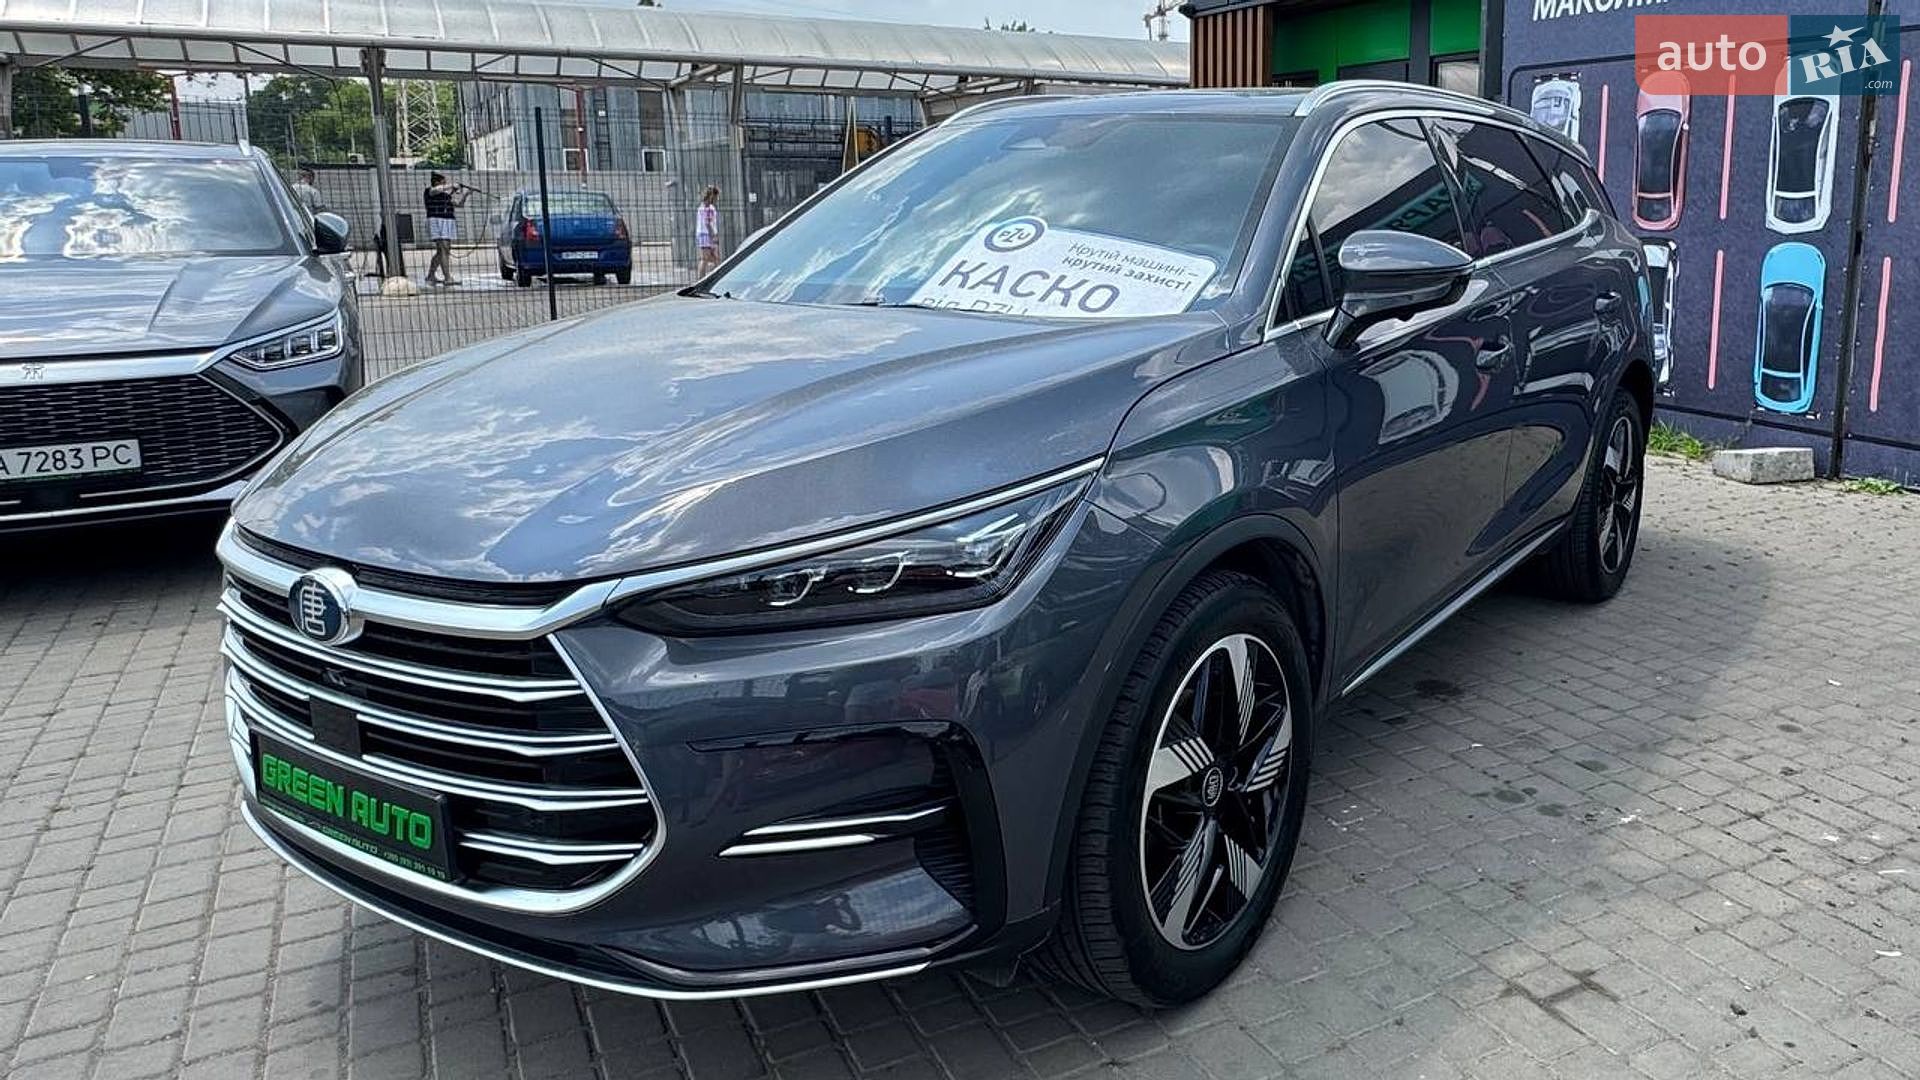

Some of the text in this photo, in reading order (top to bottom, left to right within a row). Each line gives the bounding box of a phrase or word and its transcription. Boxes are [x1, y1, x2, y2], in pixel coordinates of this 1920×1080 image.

[938, 259, 1121, 313] КАСКО
[1124, 269, 1192, 290] захист!
[17, 447, 84, 474] 7283
[92, 444, 132, 468] PC
[262, 754, 345, 818] GREEN
[352, 790, 432, 849] AUTO
